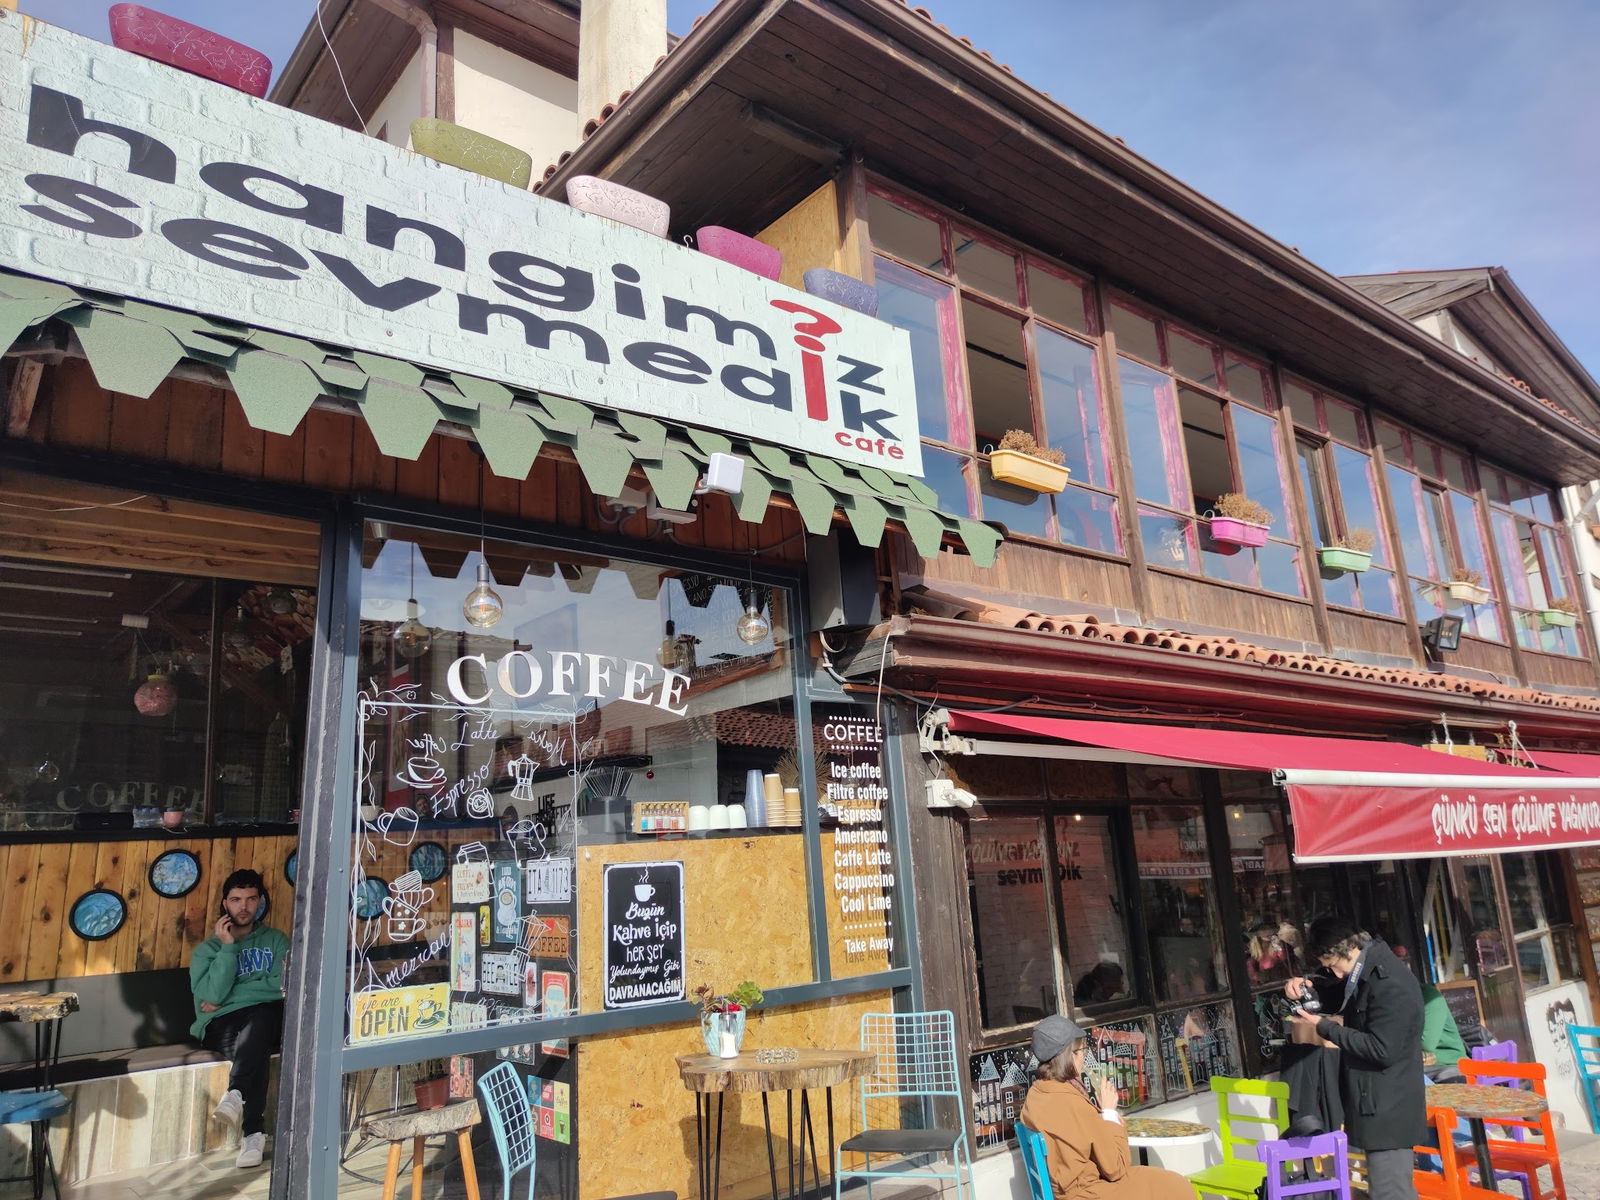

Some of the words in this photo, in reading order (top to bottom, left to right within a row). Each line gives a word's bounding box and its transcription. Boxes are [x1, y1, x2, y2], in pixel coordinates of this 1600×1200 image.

[447, 650, 691, 717] COFFEE
[450, 720, 500, 750] Latte
[824, 724, 883, 743] COFFEE
[831, 762, 847, 778] Ice
[850, 763, 881, 779] coffee
[430, 748, 495, 818] Espresso
[827, 783, 854, 800] Filtre
[857, 784, 888, 800] coffee
[838, 805, 881, 825] Espresso
[1432, 794, 1478, 844] ÇÜNKÜ
[1483, 802, 1507, 838] SEN
[1511, 795, 1557, 841] ÇÖLÜME
[834, 827, 888, 844] Americano
[834, 850, 862, 867] Caffe
[865, 849, 891, 866] Latte
[834, 871, 894, 892] Cappuccino
[625, 902, 665, 921] Bugün
[841, 895, 864, 913] Cool
[867, 894, 891, 911] Lime
[612, 923, 651, 946] Kahve
[655, 917, 677, 940] İçip
[845, 939, 866, 954] Take
[869, 937, 893, 952] Away
[664, 960, 680, 977] Gibi
[609, 978, 681, 1001] DAVRANACAĞIM
[380, 997, 400, 1007] are
[361, 1006, 409, 1038] OPEN
